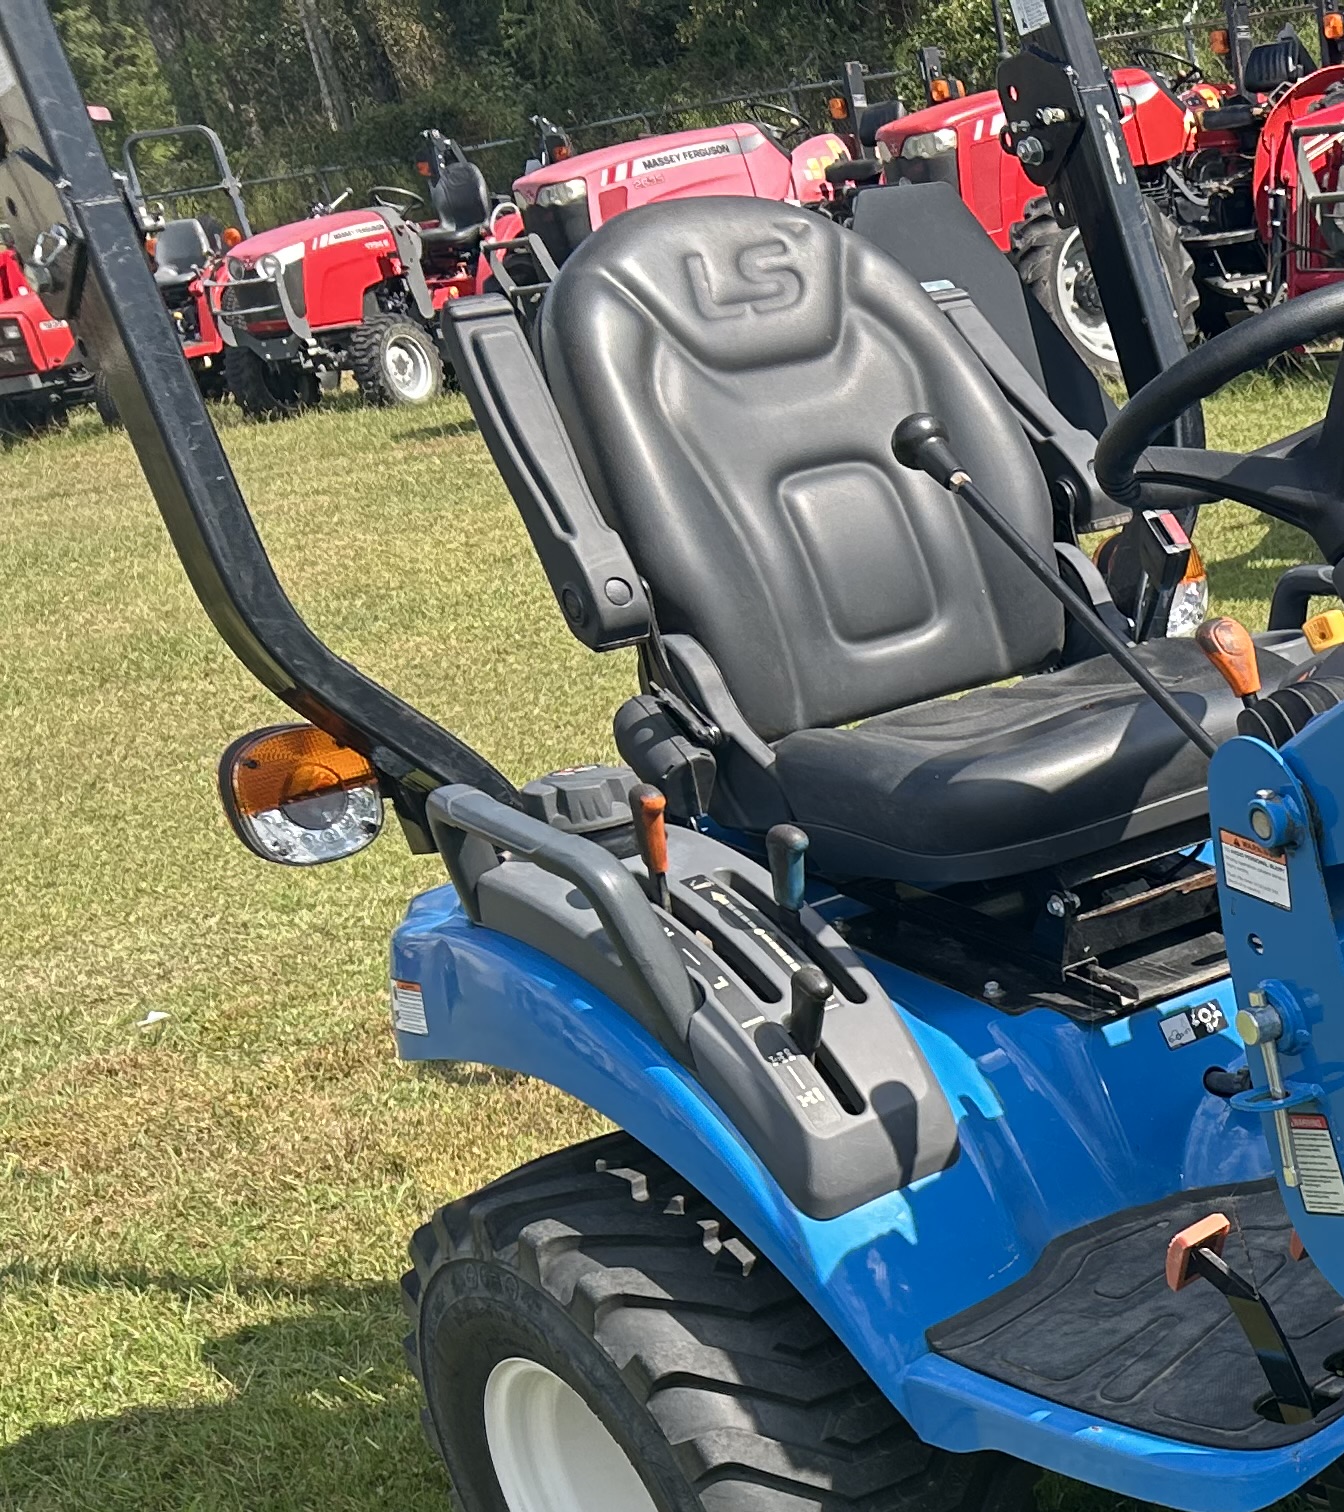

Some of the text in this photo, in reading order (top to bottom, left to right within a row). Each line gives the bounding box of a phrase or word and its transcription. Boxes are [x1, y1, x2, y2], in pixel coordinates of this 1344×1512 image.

[642, 144, 731, 171] MASSEY FERGUSON
[682, 238, 805, 321] LS
